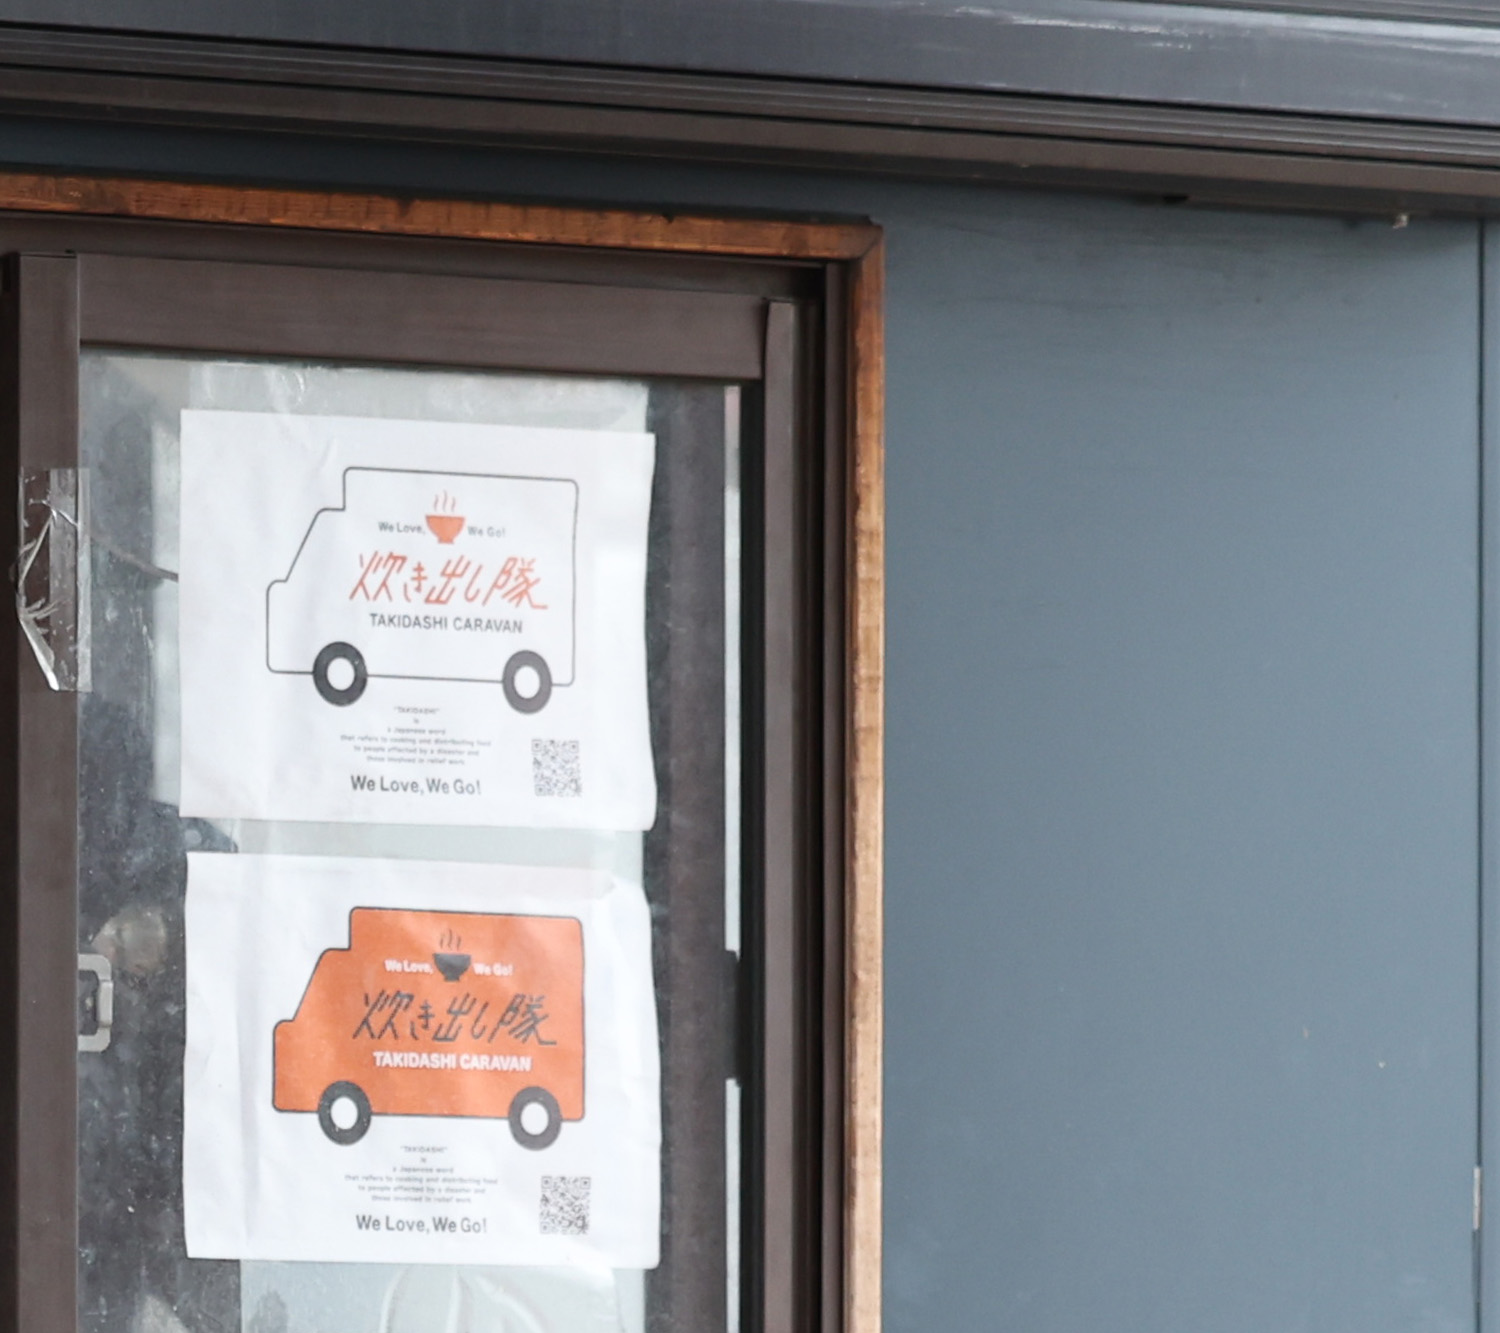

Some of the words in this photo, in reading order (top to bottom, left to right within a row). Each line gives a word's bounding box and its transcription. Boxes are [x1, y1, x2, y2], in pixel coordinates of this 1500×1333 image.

[378, 521, 394, 532] We
[467, 526, 483, 536] We
[487, 527, 506, 538] Go!
[349, 551, 548, 609] 炊き出し隊
[370, 613, 448, 630] TAKIDASHI
[453, 616, 523, 633] CARAVAN
[350, 775, 375, 791] We
[380, 776, 424, 795] Love,
[426, 778, 450, 793] We
[454, 779, 481, 795] Go!
[385, 960, 402, 972] We
[473, 964, 491, 975] We
[352, 990, 557, 1045] 炊き出し隊
[373, 1051, 456, 1068] TAKIDASHI
[460, 1054, 532, 1071] CARAVAN
[356, 1215, 381, 1231] We
[386, 1215, 430, 1234] Love,
[432, 1217, 456, 1232] We
[461, 1217, 487, 1233] Go!
